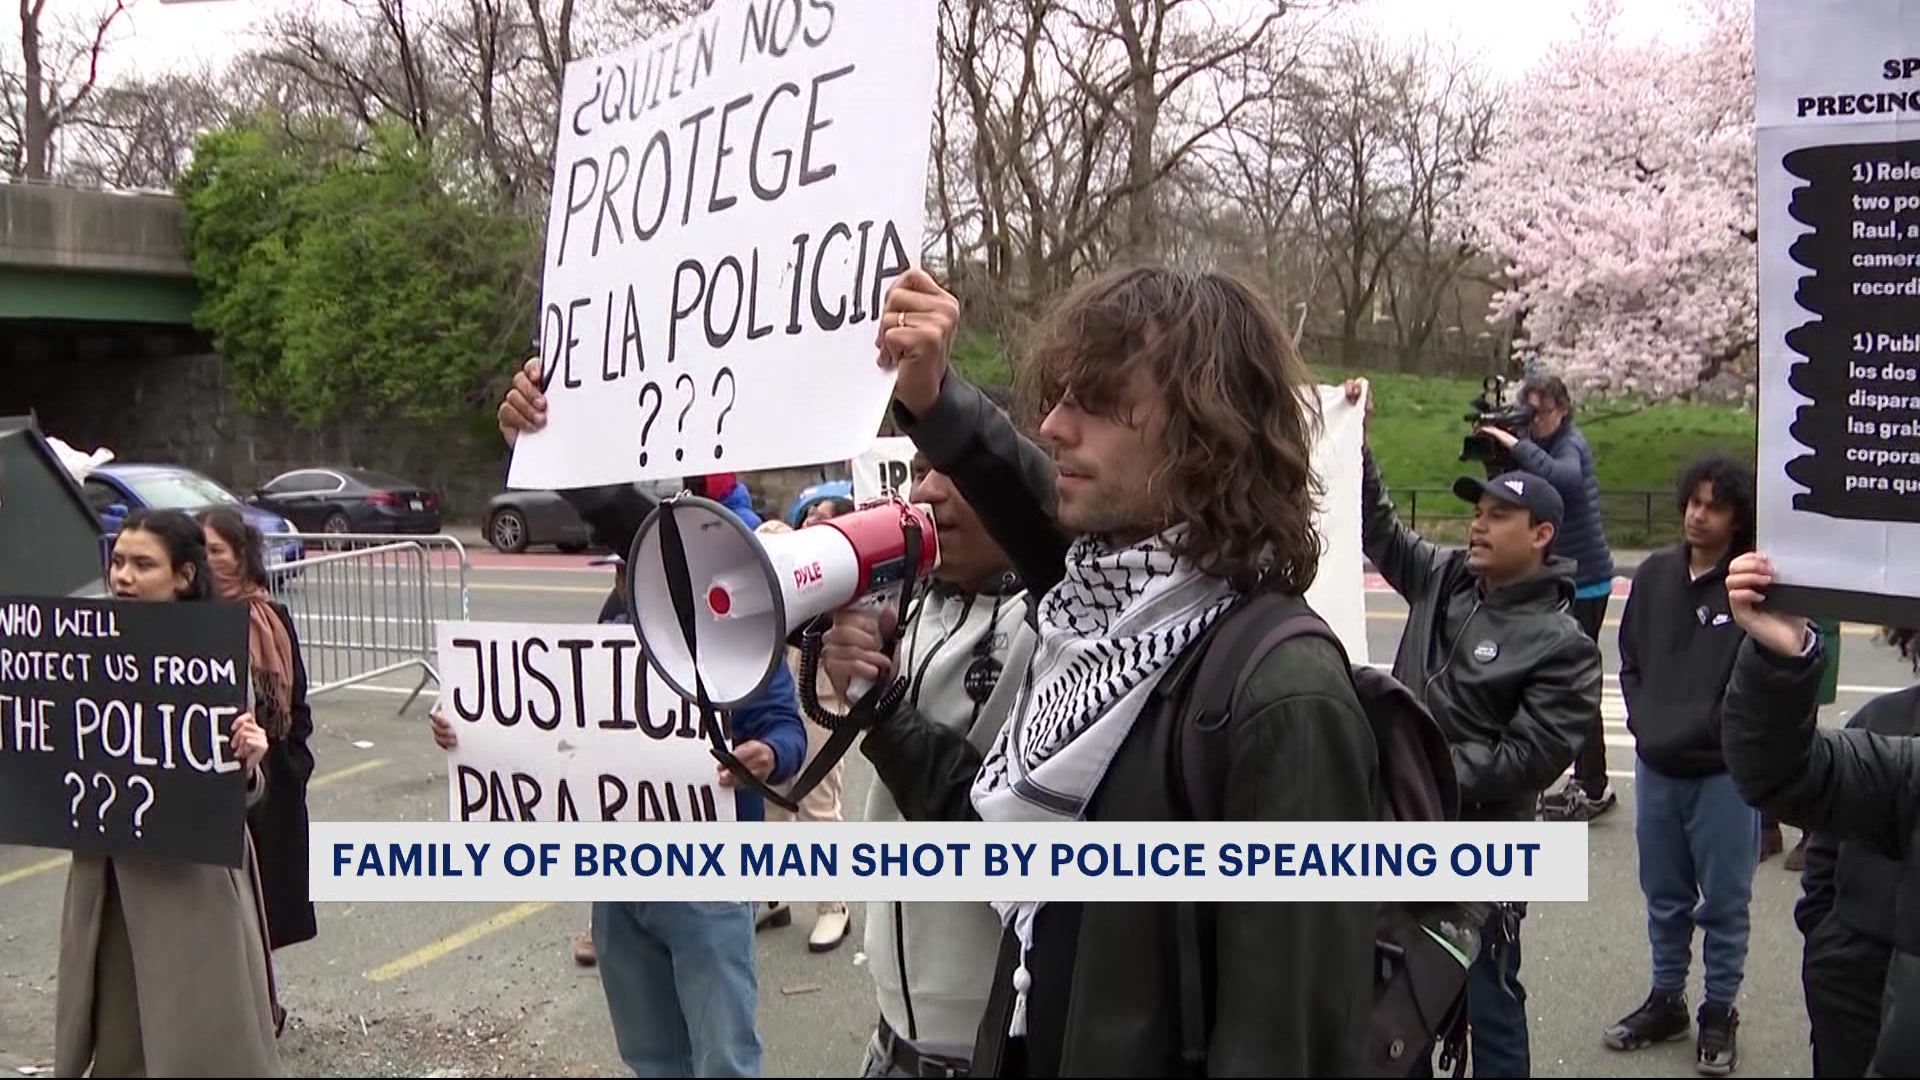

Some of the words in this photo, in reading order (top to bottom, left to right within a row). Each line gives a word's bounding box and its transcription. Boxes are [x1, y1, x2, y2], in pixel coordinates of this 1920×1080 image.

[738, 0, 836, 64] NOS
[1882, 57, 1920, 80] SP
[557, 63, 856, 268] PROTEGE
[1852, 194, 1891, 211] two
[1894, 195, 1920, 214] po
[1852, 220, 1904, 241] Raul,
[540, 297, 592, 394] DE
[602, 283, 646, 382] LA
[667, 219, 912, 363] POLICIA
[1877, 332, 1920, 353] Publ
[1849, 360, 1878, 380] los
[1881, 362, 1917, 381] dos
[1848, 388, 1920, 412] dispara
[1847, 415, 1876, 434] las
[1846, 447, 1920, 467] corpora
[1845, 475, 1889, 492] para
[1892, 478, 1920, 495] qu
[793, 561, 822, 589] PYLE
[0, 603, 42, 638] WHO
[55, 607, 120, 637] WILL
[105, 654, 139, 683] US
[154, 655, 237, 685] FROM
[452, 637, 732, 741] JUSTIC
[0, 694, 56, 752] THE
[75, 697, 242, 774] POLICE
